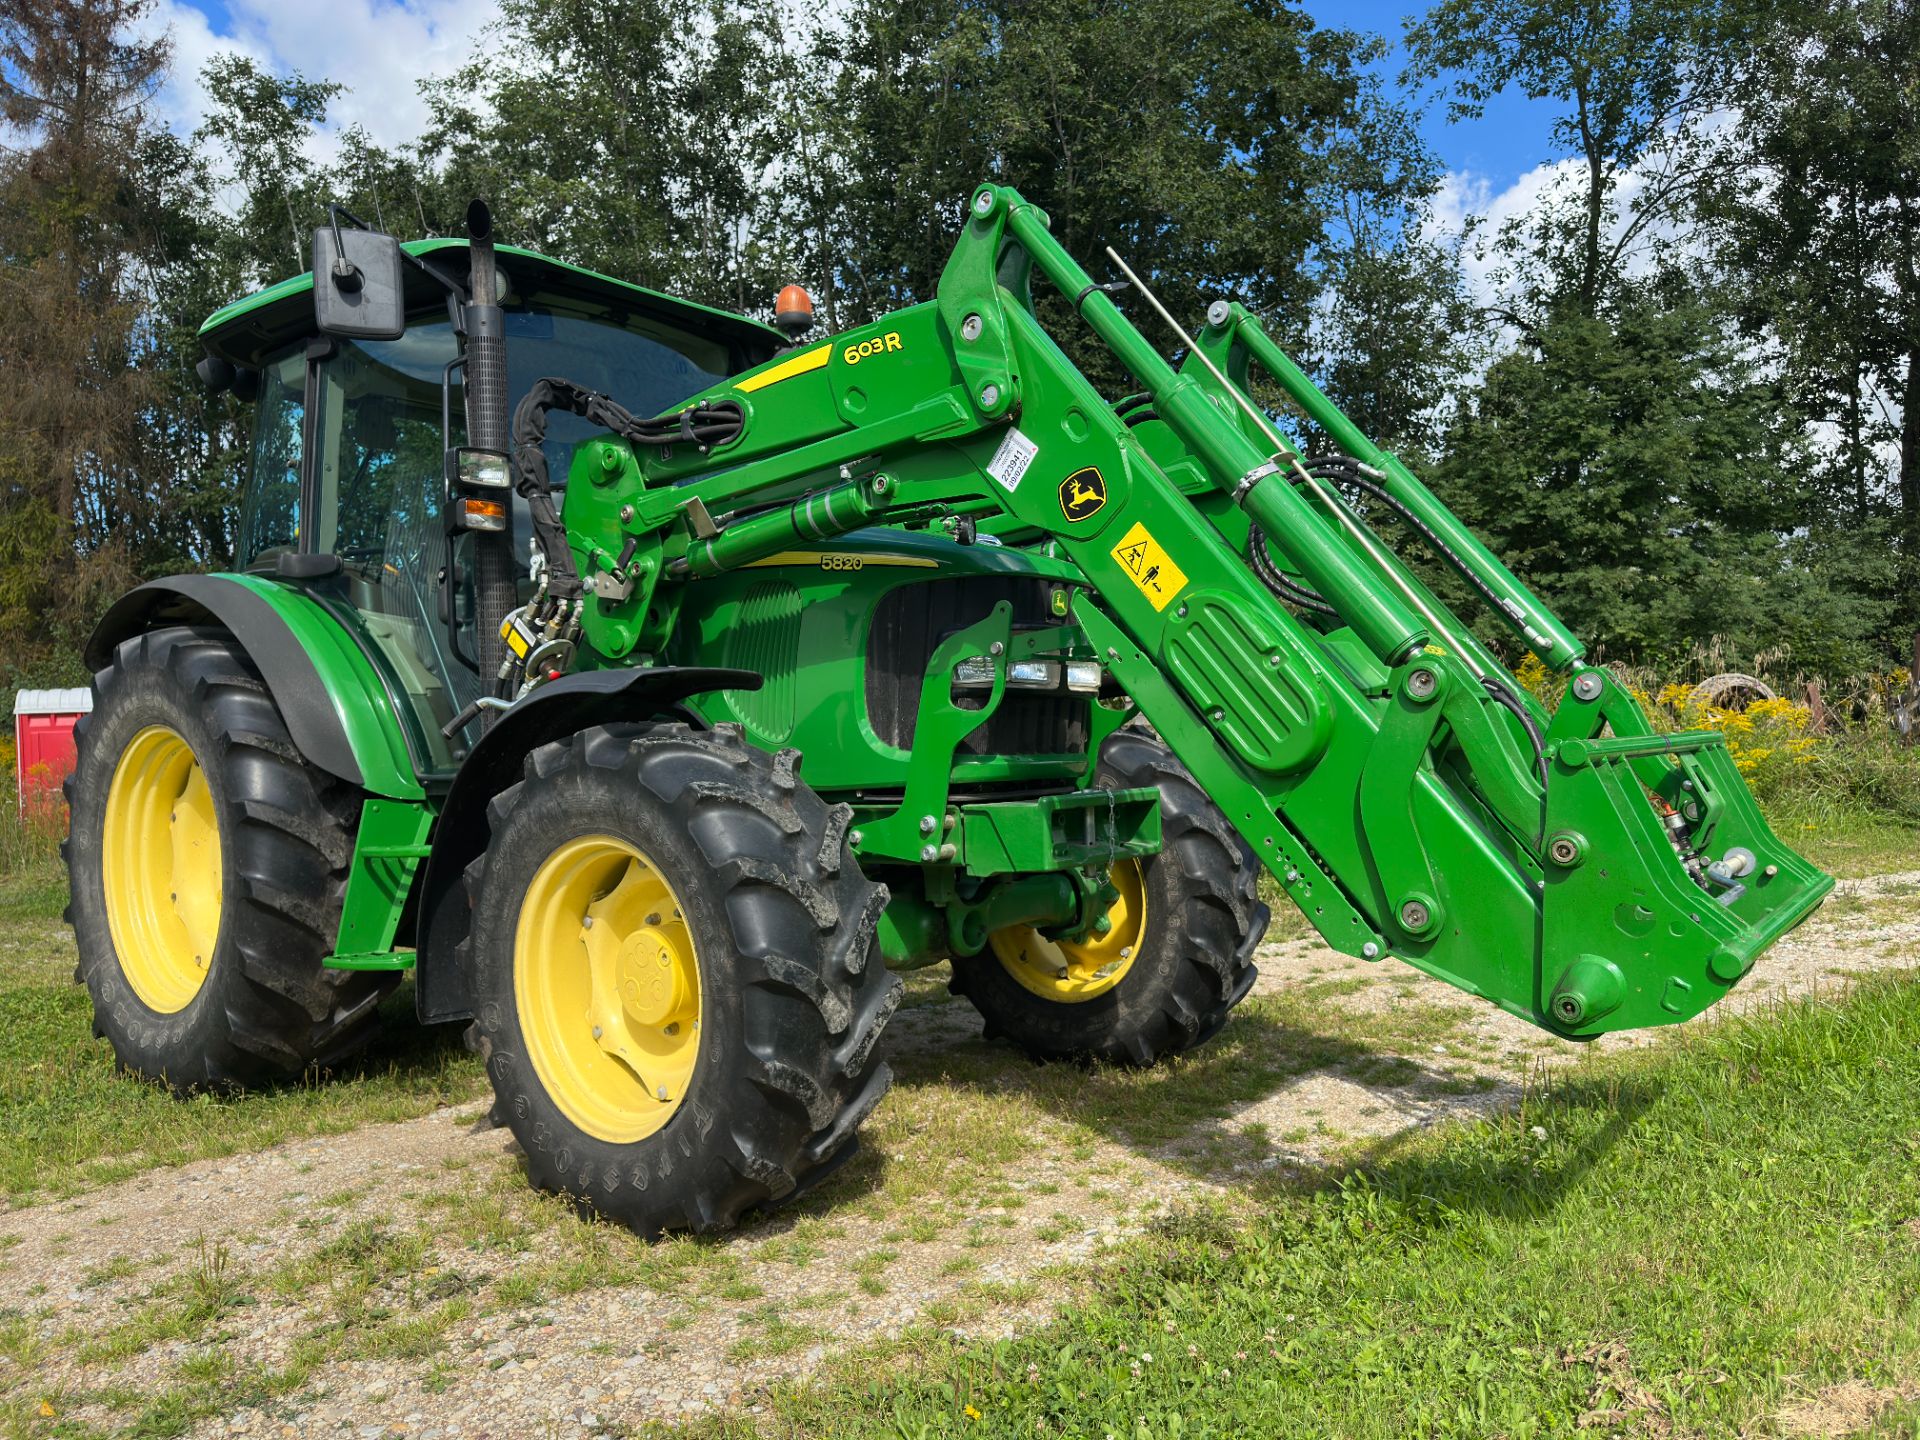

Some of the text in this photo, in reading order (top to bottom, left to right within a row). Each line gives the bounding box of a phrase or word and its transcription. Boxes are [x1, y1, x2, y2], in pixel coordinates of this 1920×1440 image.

[844, 332, 903, 365] 603R
[1002, 450, 1023, 481] 223941
[821, 555, 863, 571] 5820
[514, 1095, 713, 1193] Firestone
